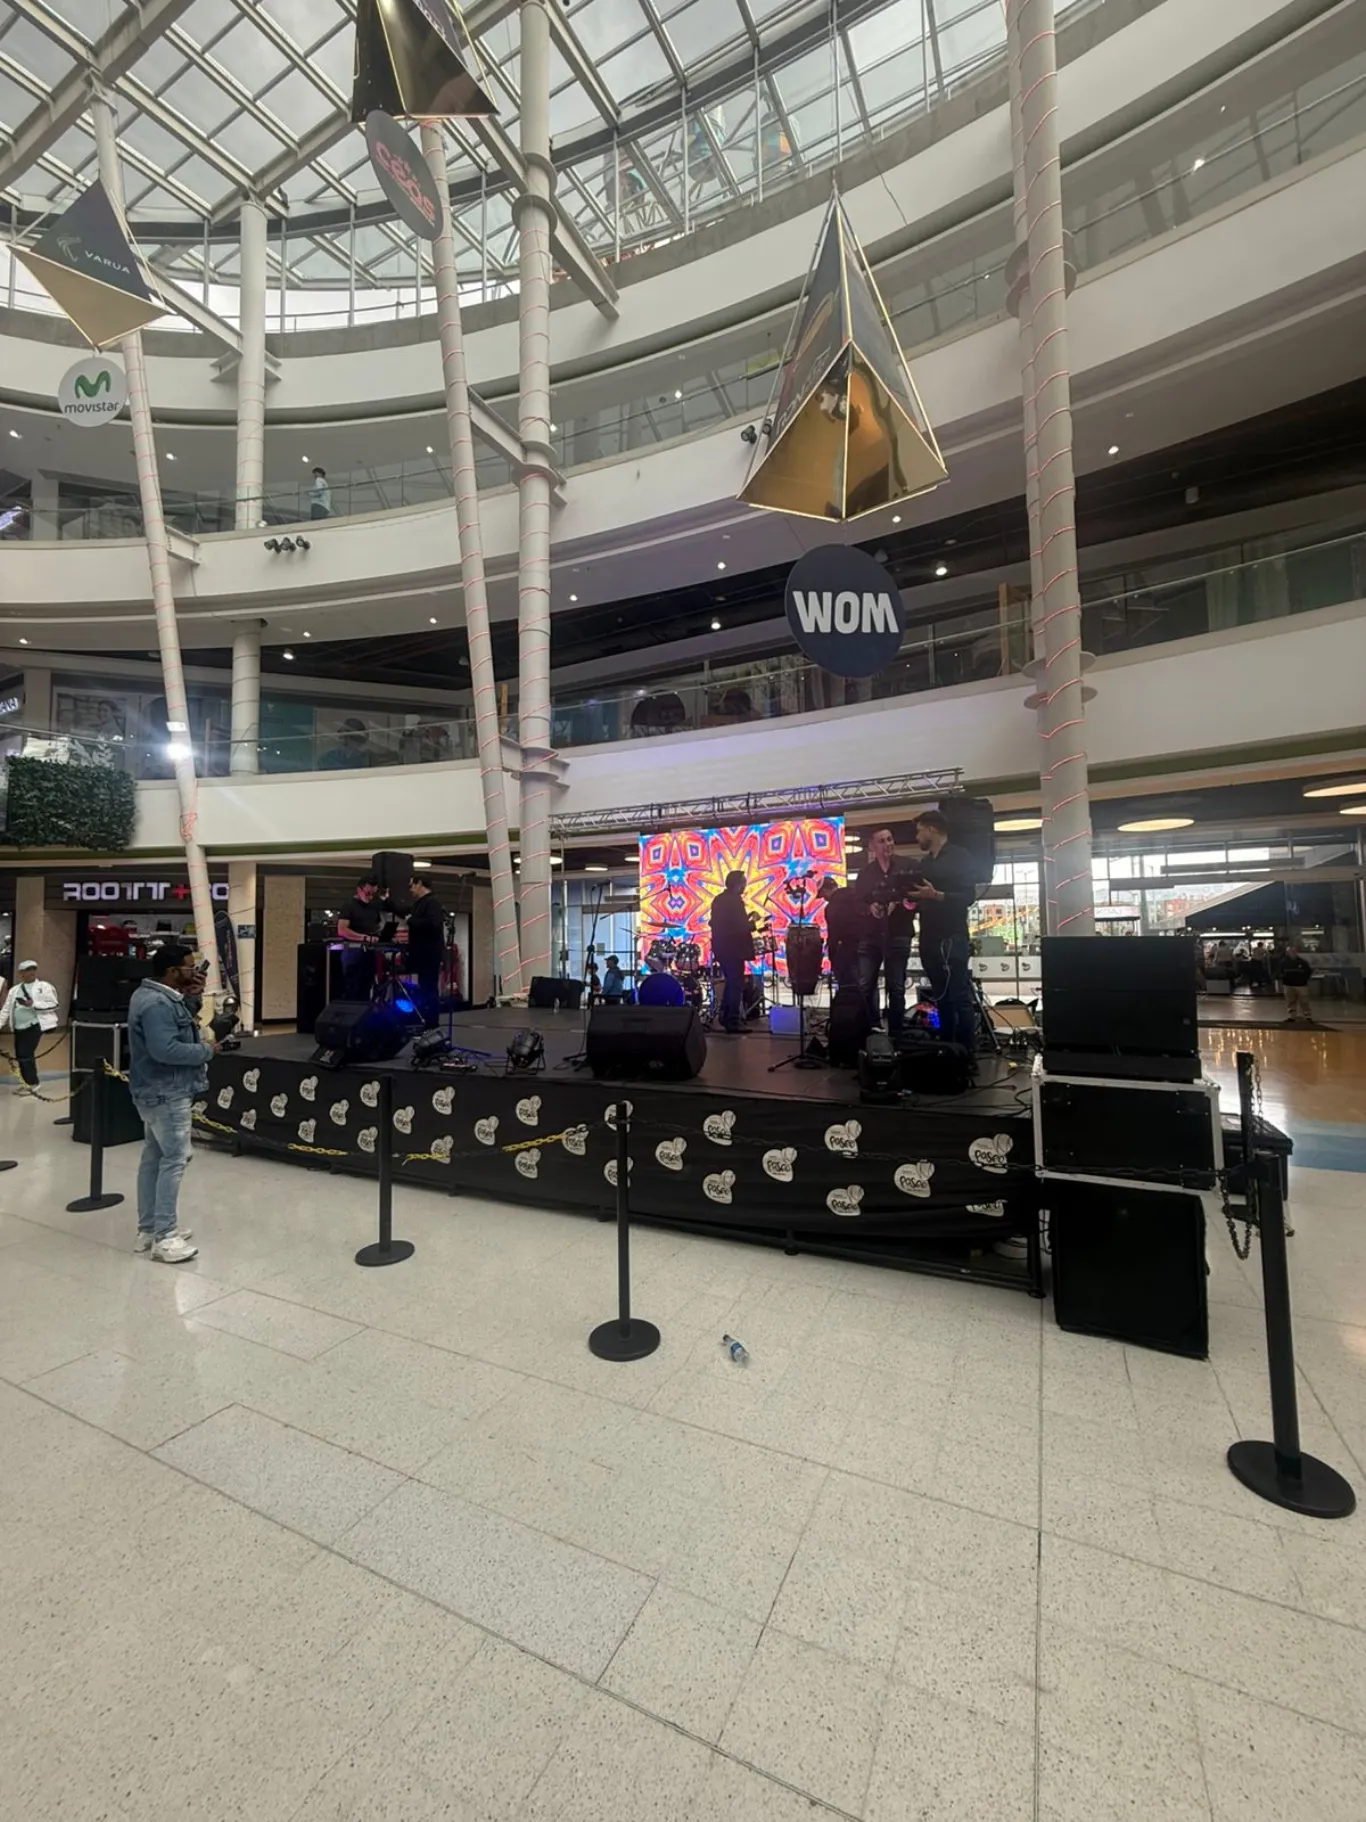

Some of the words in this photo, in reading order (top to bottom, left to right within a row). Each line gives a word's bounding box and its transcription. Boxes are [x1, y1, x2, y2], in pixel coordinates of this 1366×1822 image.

[84, 249, 131, 275] VARUA
[64, 401, 119, 414] movistar
[792, 590, 900, 635] WOM
